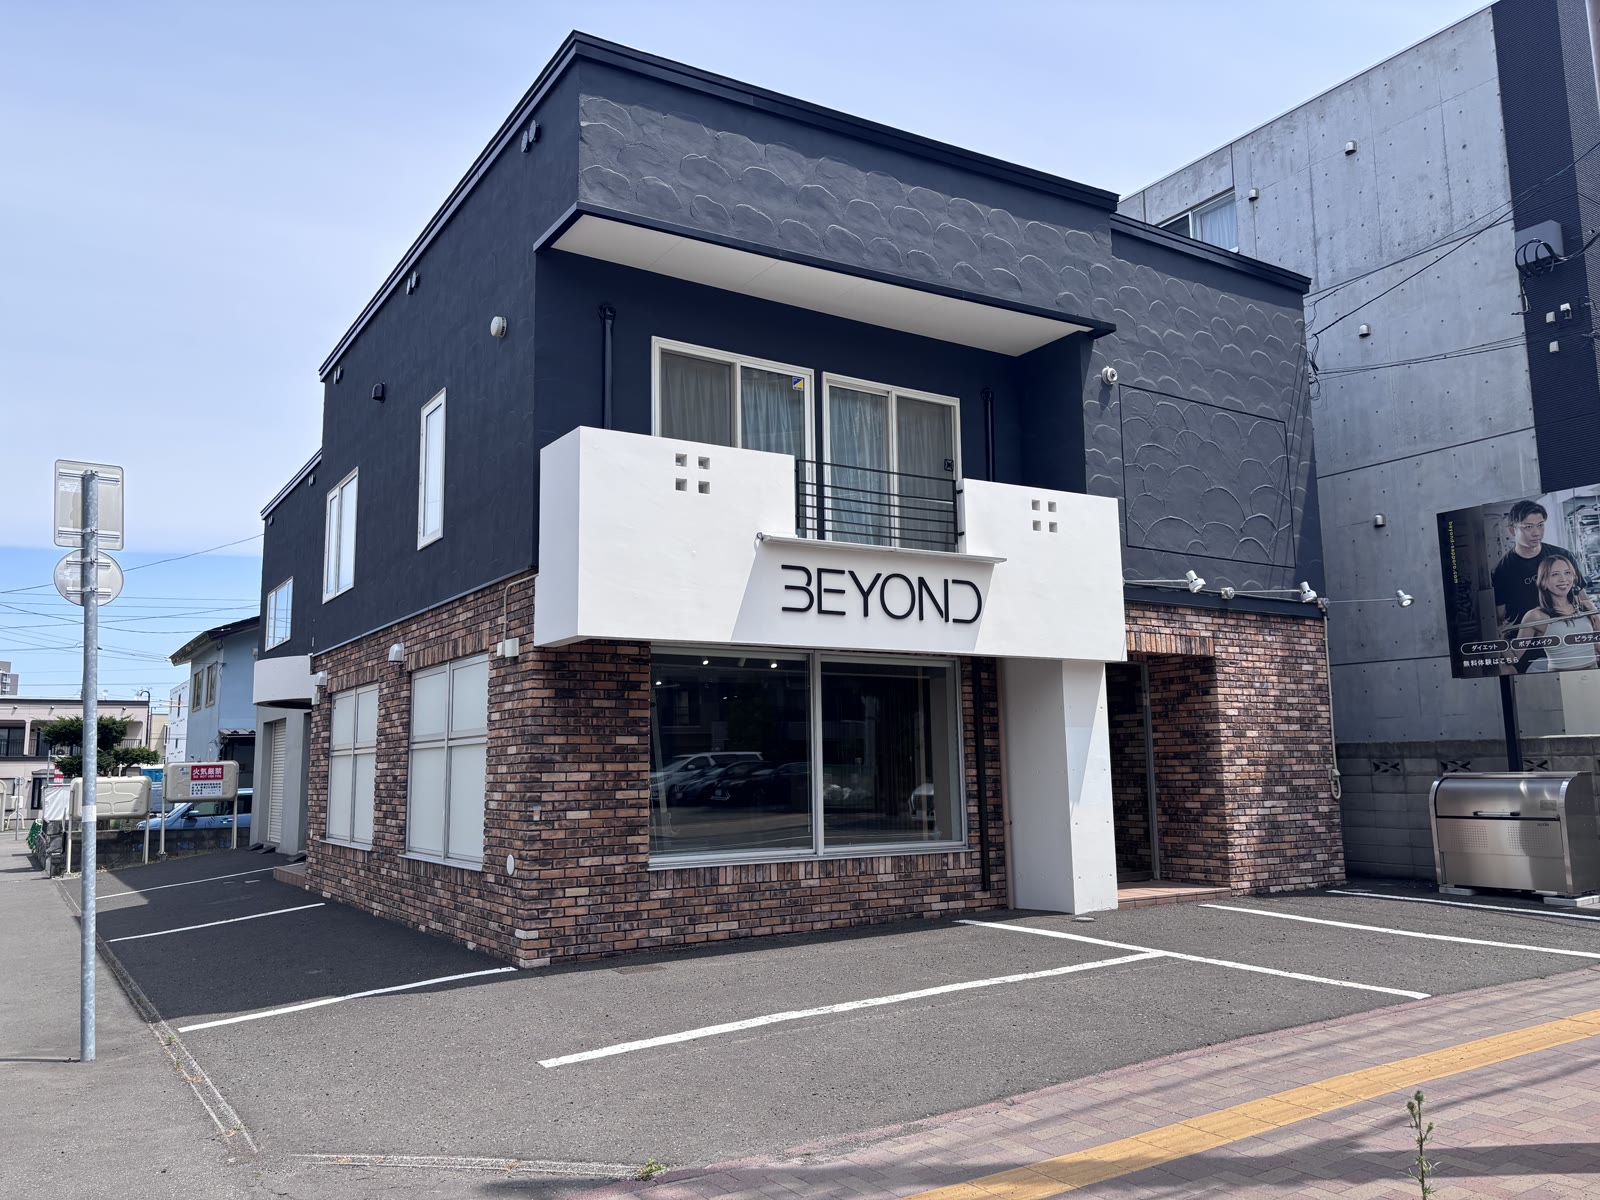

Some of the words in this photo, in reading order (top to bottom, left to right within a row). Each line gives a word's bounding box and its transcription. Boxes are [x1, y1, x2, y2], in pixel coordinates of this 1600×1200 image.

[781, 564, 982, 624] BEYOND
[1574, 633, 1600, 642] ピラティ
[1463, 657, 1519, 667] 無料体験はこちら
